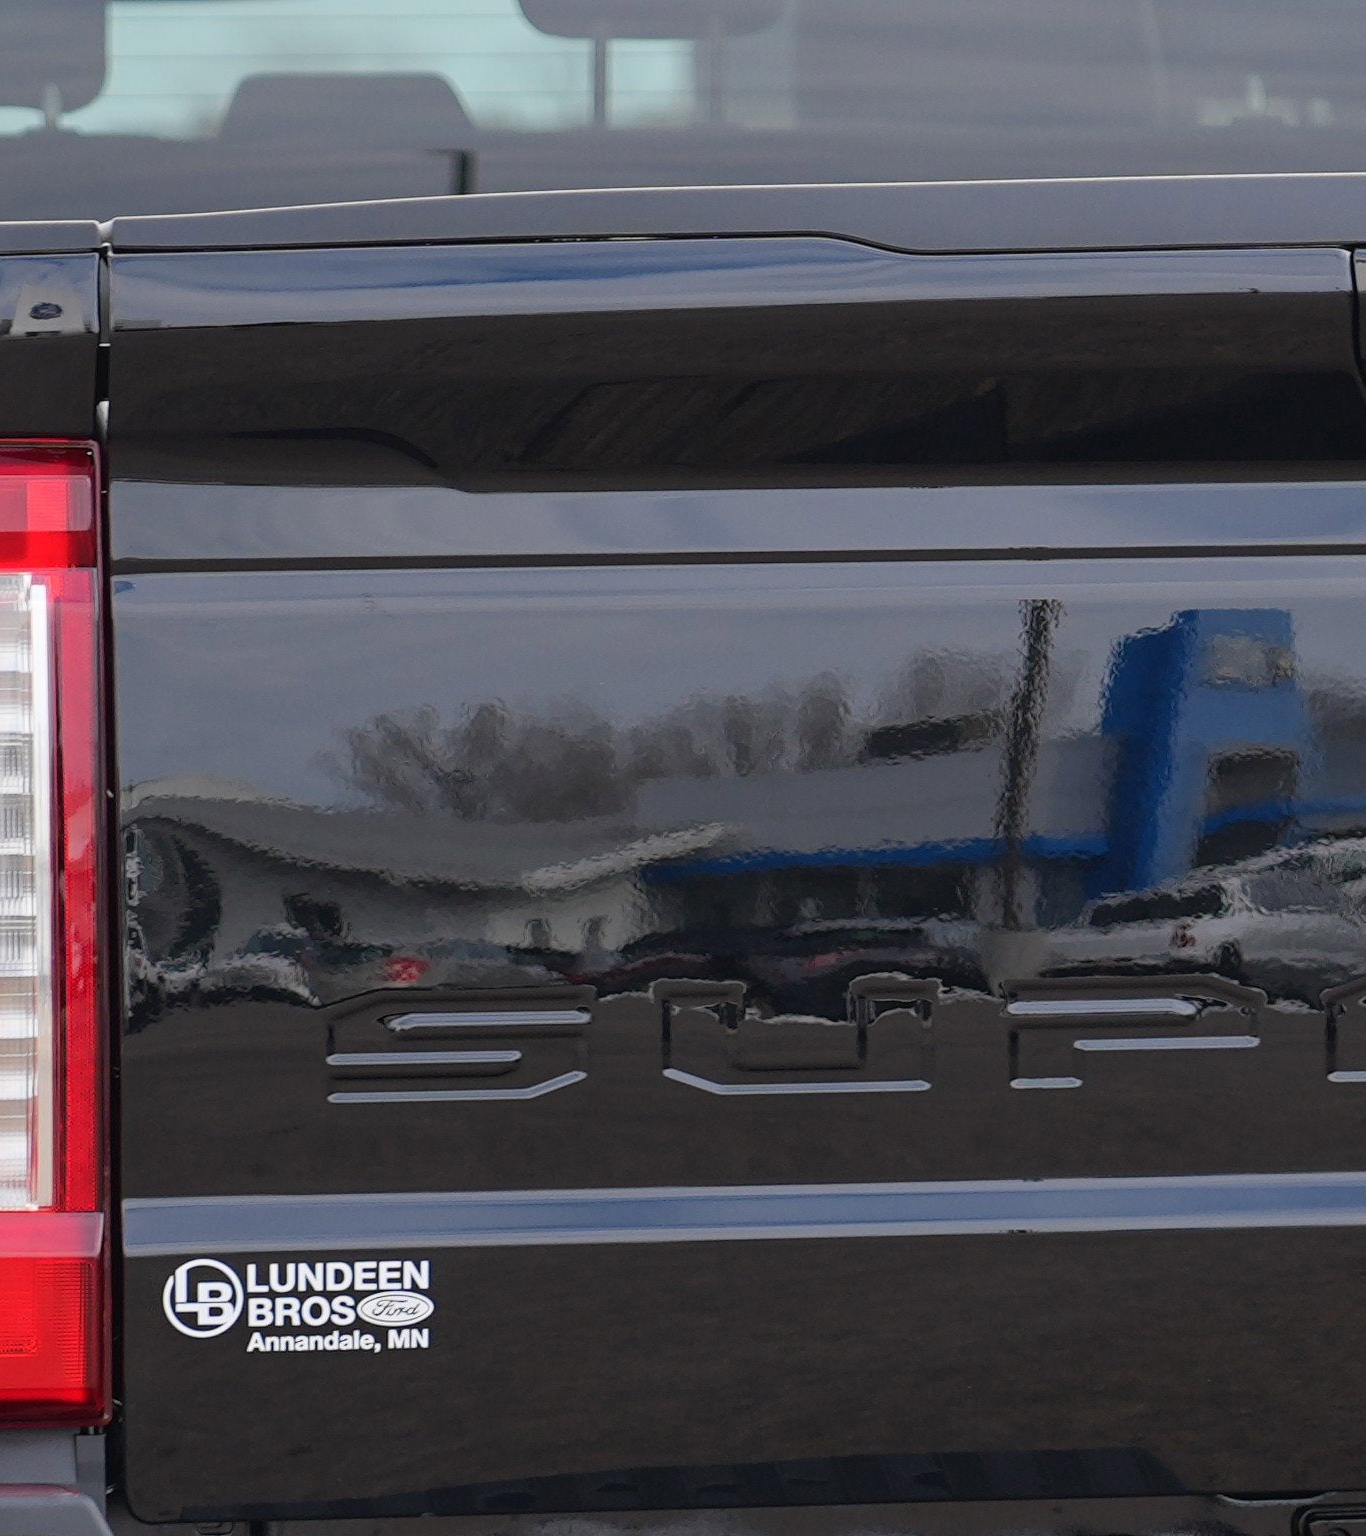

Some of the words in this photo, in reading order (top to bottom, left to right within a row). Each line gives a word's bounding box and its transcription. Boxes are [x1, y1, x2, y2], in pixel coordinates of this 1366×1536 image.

[246, 1259, 430, 1293] LUNDEEN
[247, 1295, 357, 1328] BROS
[245, 1330, 382, 1353] Annandale,
[387, 1328, 430, 1349] MN
